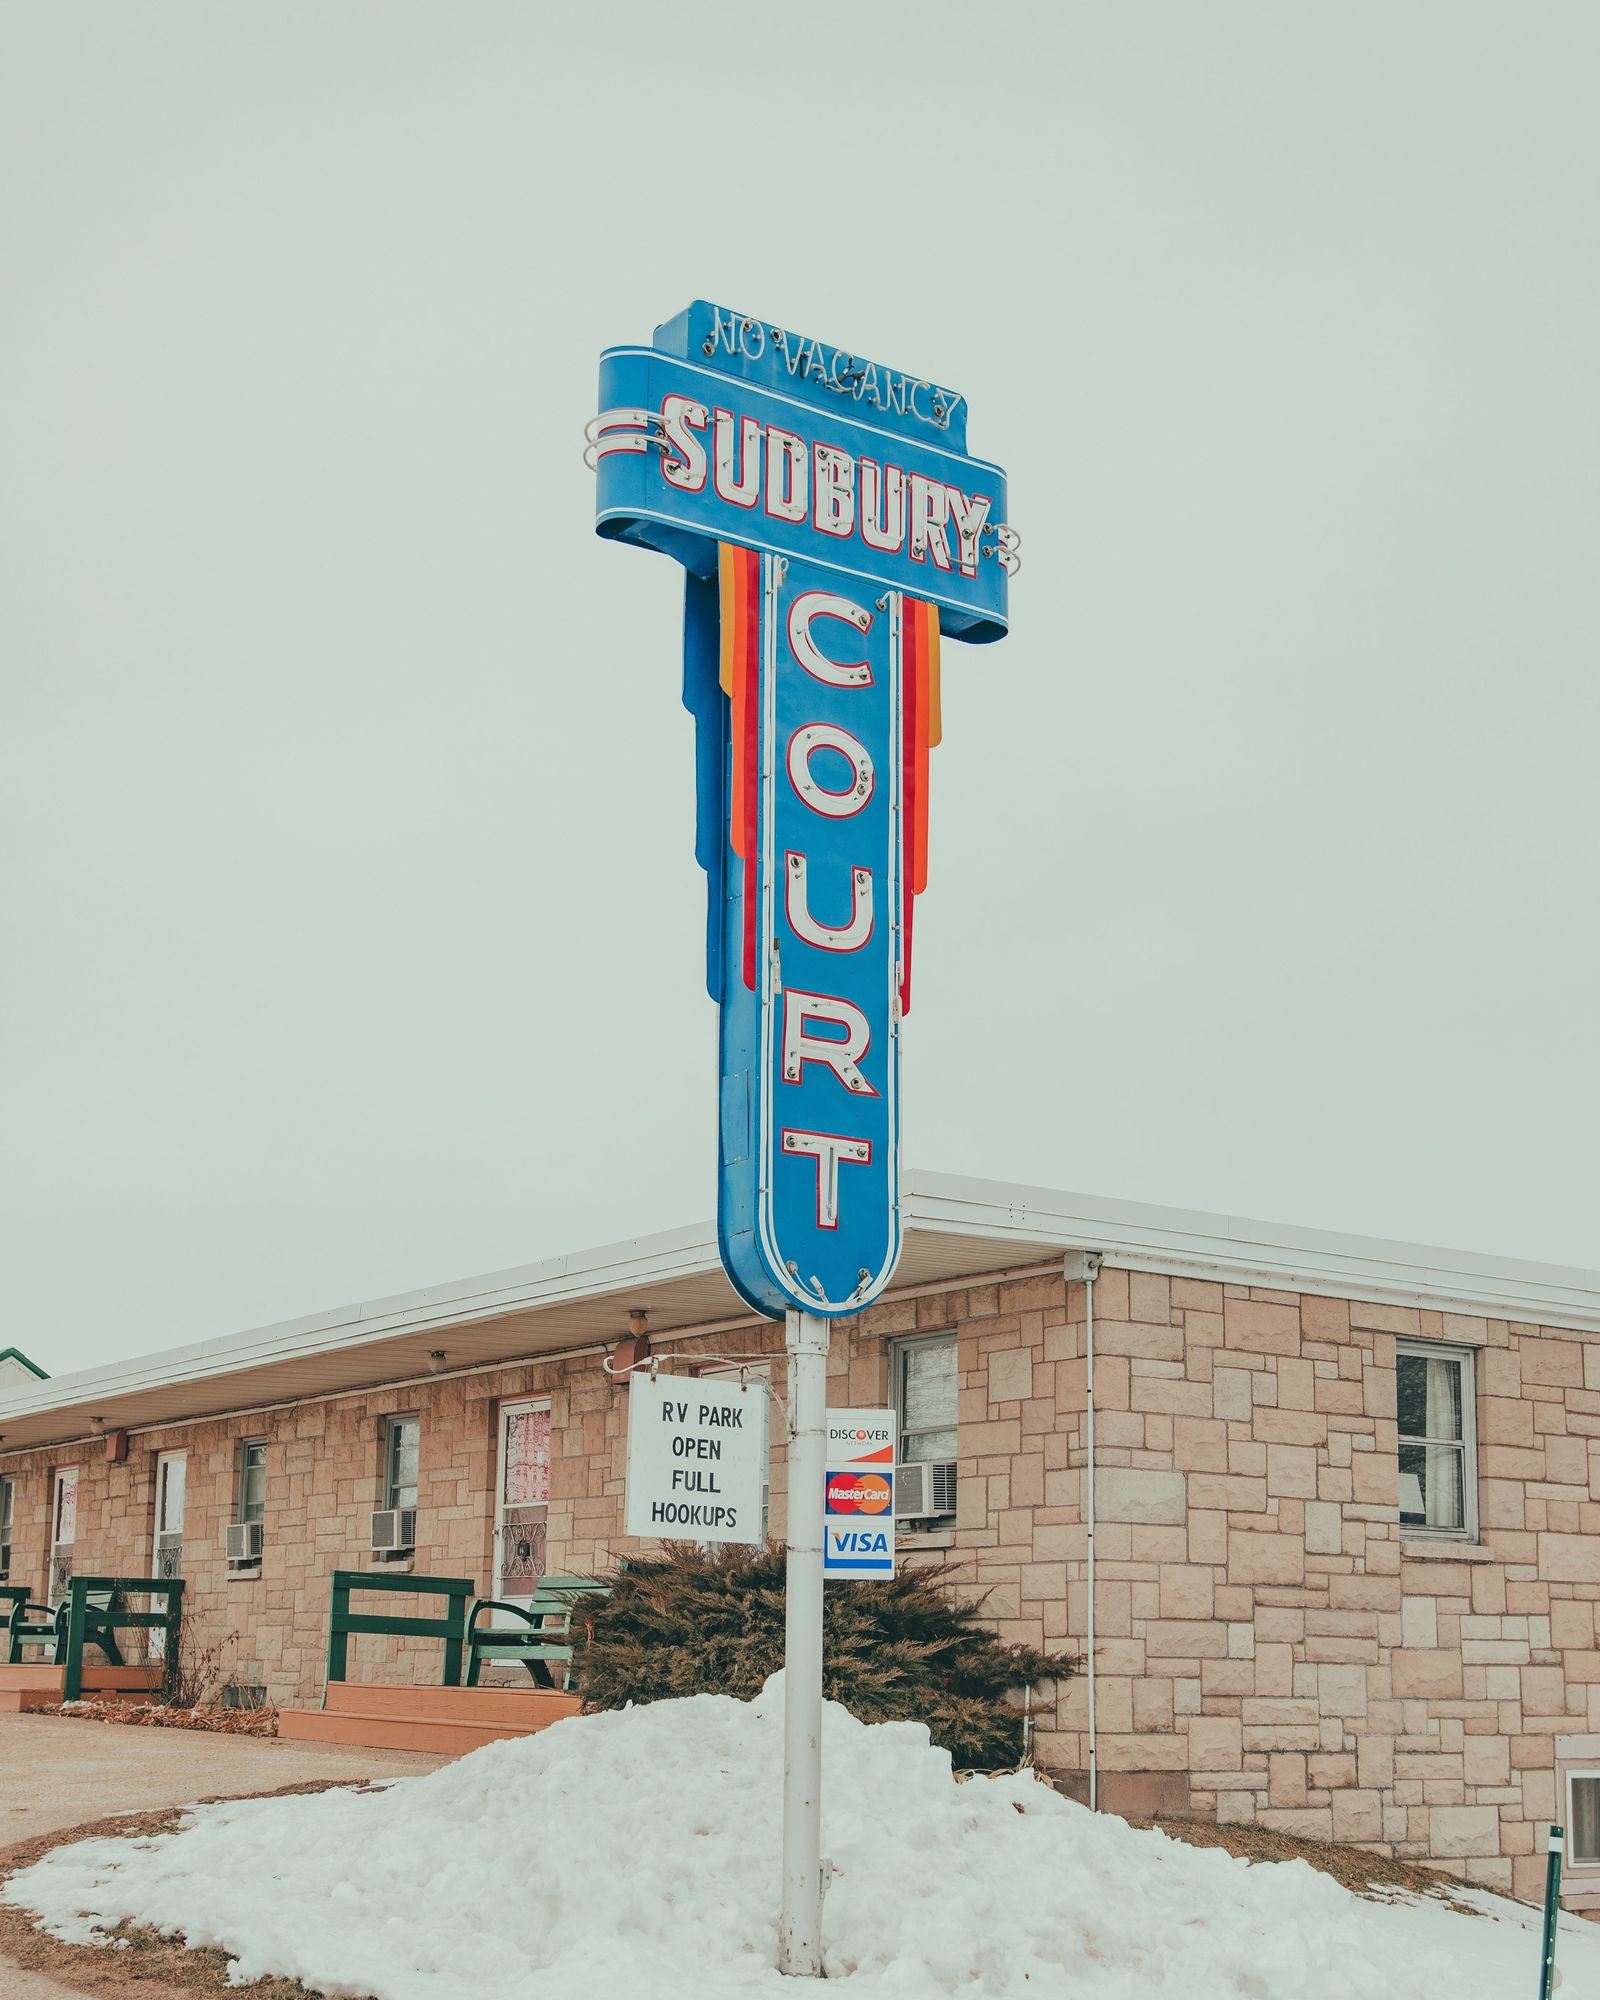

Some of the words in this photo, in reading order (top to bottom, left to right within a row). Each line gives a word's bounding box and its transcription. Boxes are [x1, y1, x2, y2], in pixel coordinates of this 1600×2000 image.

[710, 306, 765, 361] NO
[780, 329, 962, 431] VACANCY
[661, 393, 992, 579] SUDBURY
[780, 589, 882, 1230] COURT
[662, 1401, 688, 1422] RV
[699, 1404, 743, 1428] PARK
[830, 1428, 889, 1441] DISCOVER
[672, 1436, 721, 1460] OPEN
[671, 1469, 721, 1494] FULL
[829, 1488, 889, 1501] MasterCard
[651, 1501, 737, 1528] HOOKUPS
[833, 1533, 888, 1552] VISA
